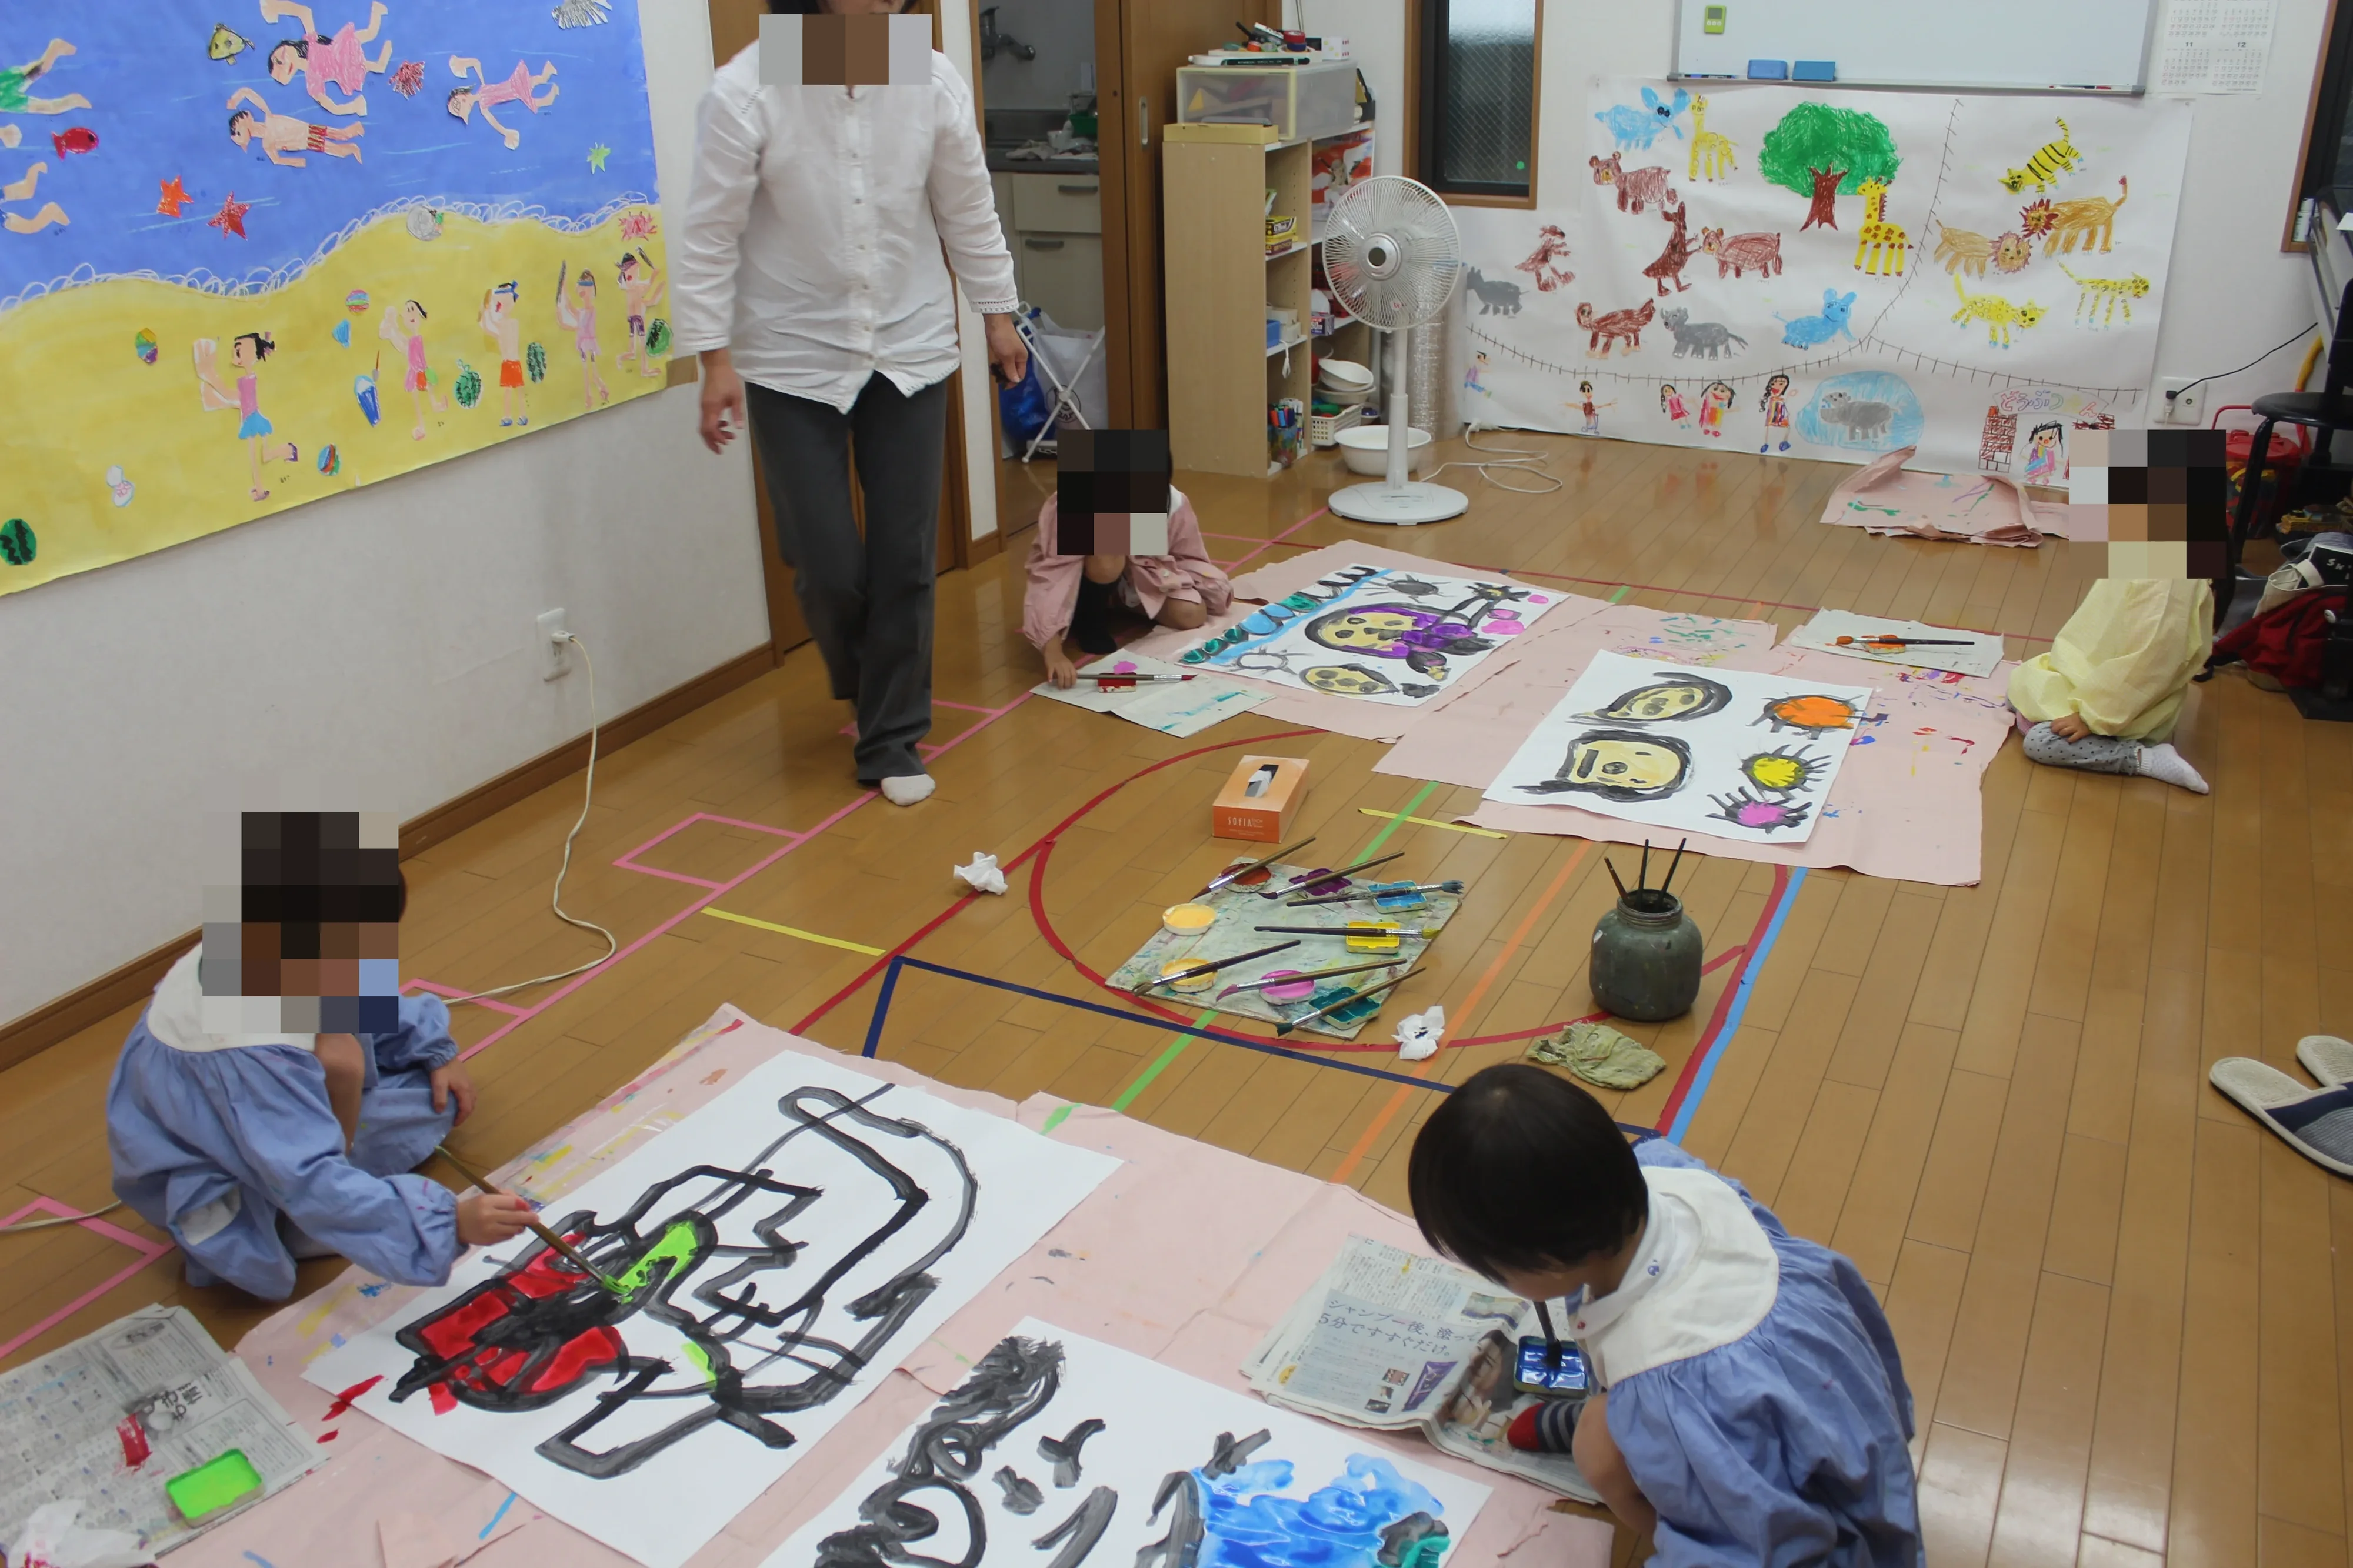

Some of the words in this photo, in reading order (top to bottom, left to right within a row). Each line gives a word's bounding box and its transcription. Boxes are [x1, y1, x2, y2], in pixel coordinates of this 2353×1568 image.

[1318, 1313, 1450, 1356] 5分ですすぐだけ。
[1328, 1300, 1481, 1342] シャンプー後、塗って
